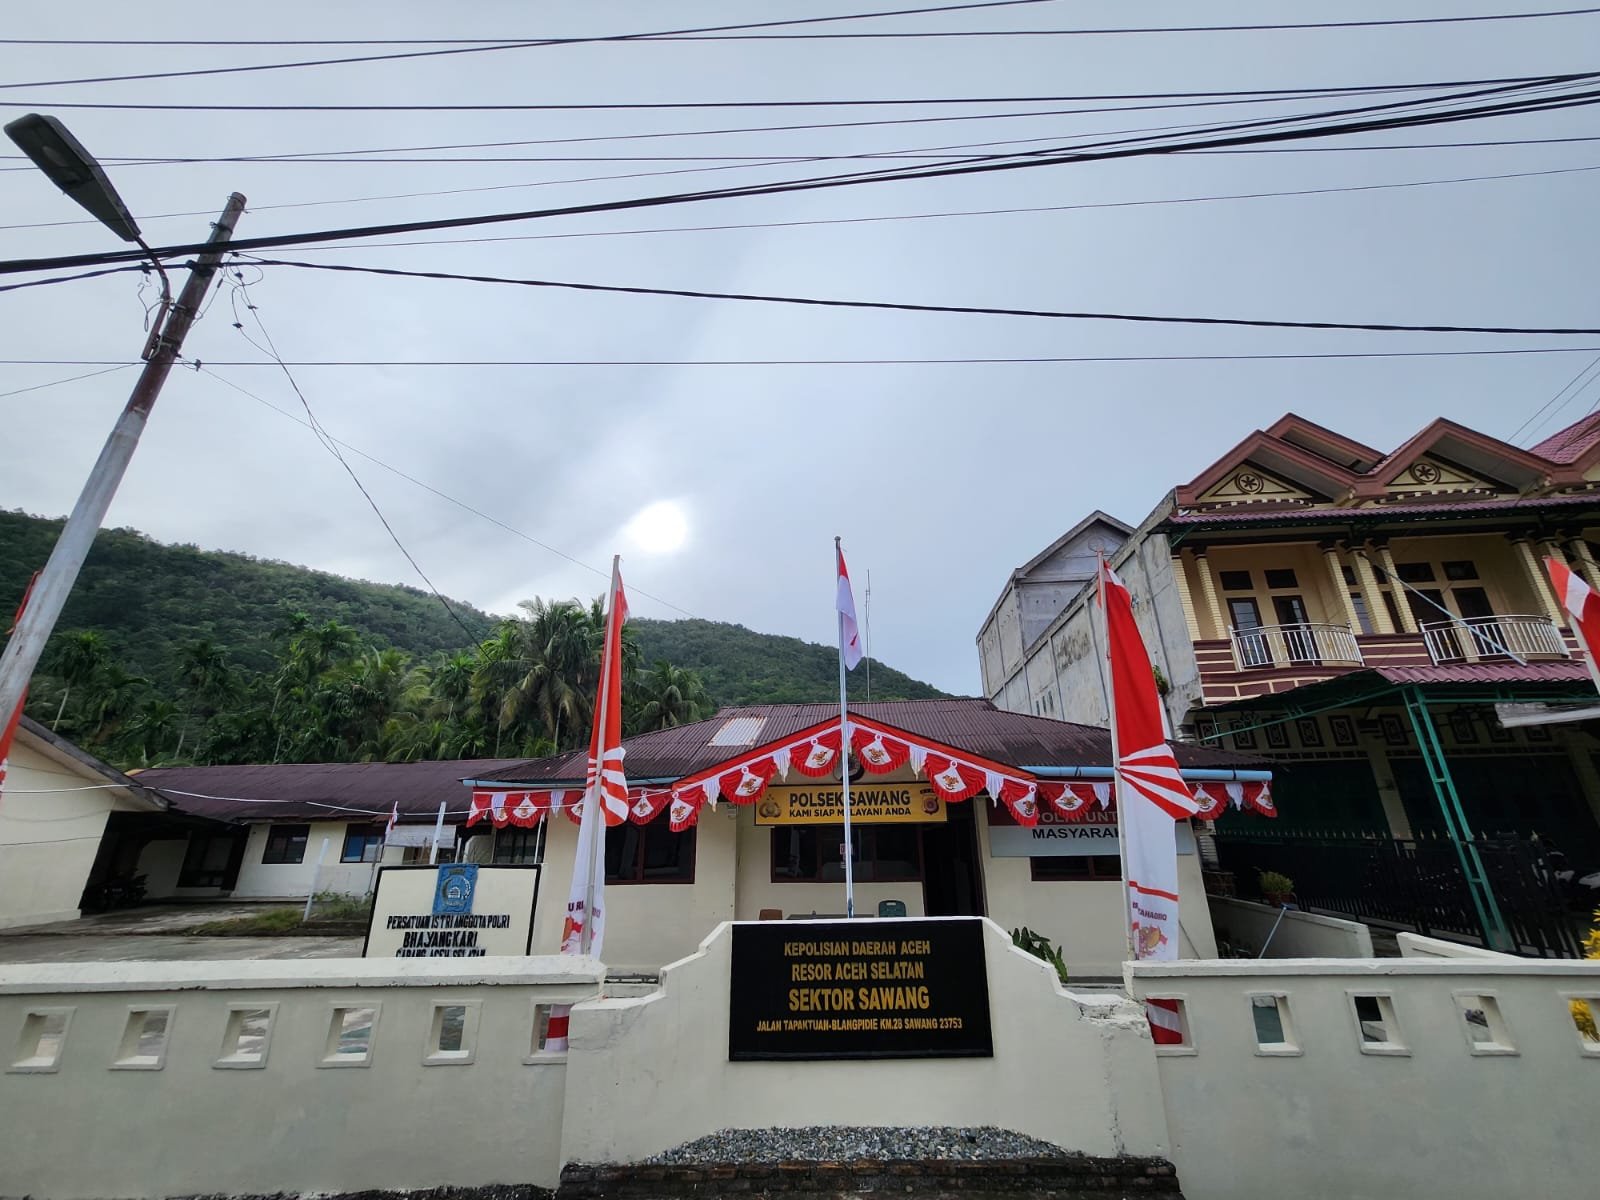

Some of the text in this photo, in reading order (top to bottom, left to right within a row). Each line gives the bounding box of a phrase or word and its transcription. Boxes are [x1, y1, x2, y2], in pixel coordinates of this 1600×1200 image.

[789, 790, 911, 807] POLSEK SAWANG
[789, 807, 912, 817] KAMI SIAP MLAYANI ANDA
[1085, 811, 1118, 822] UNT
[1032, 827, 1119, 839] MASYARA
[386, 915, 430, 929] PERSATUAN
[453, 914, 486, 929] ANGGOTA
[486, 914, 510, 929] POLRI
[402, 931, 479, 948] BHAYANGKARI
[784, 940, 931, 956] KEPOLISIAN DAERAH ACEH
[791, 961, 925, 981] RESOR ACEH SELATAN
[788, 985, 930, 1011] SEKTOR SAWANG
[756, 1020, 782, 1032] JALAN
[783, 1018, 879, 1031] TAPAKTUAN-BLANGPIDIE
[904, 1018, 938, 1030] SAWANG
[939, 1017, 963, 1029] 23753
